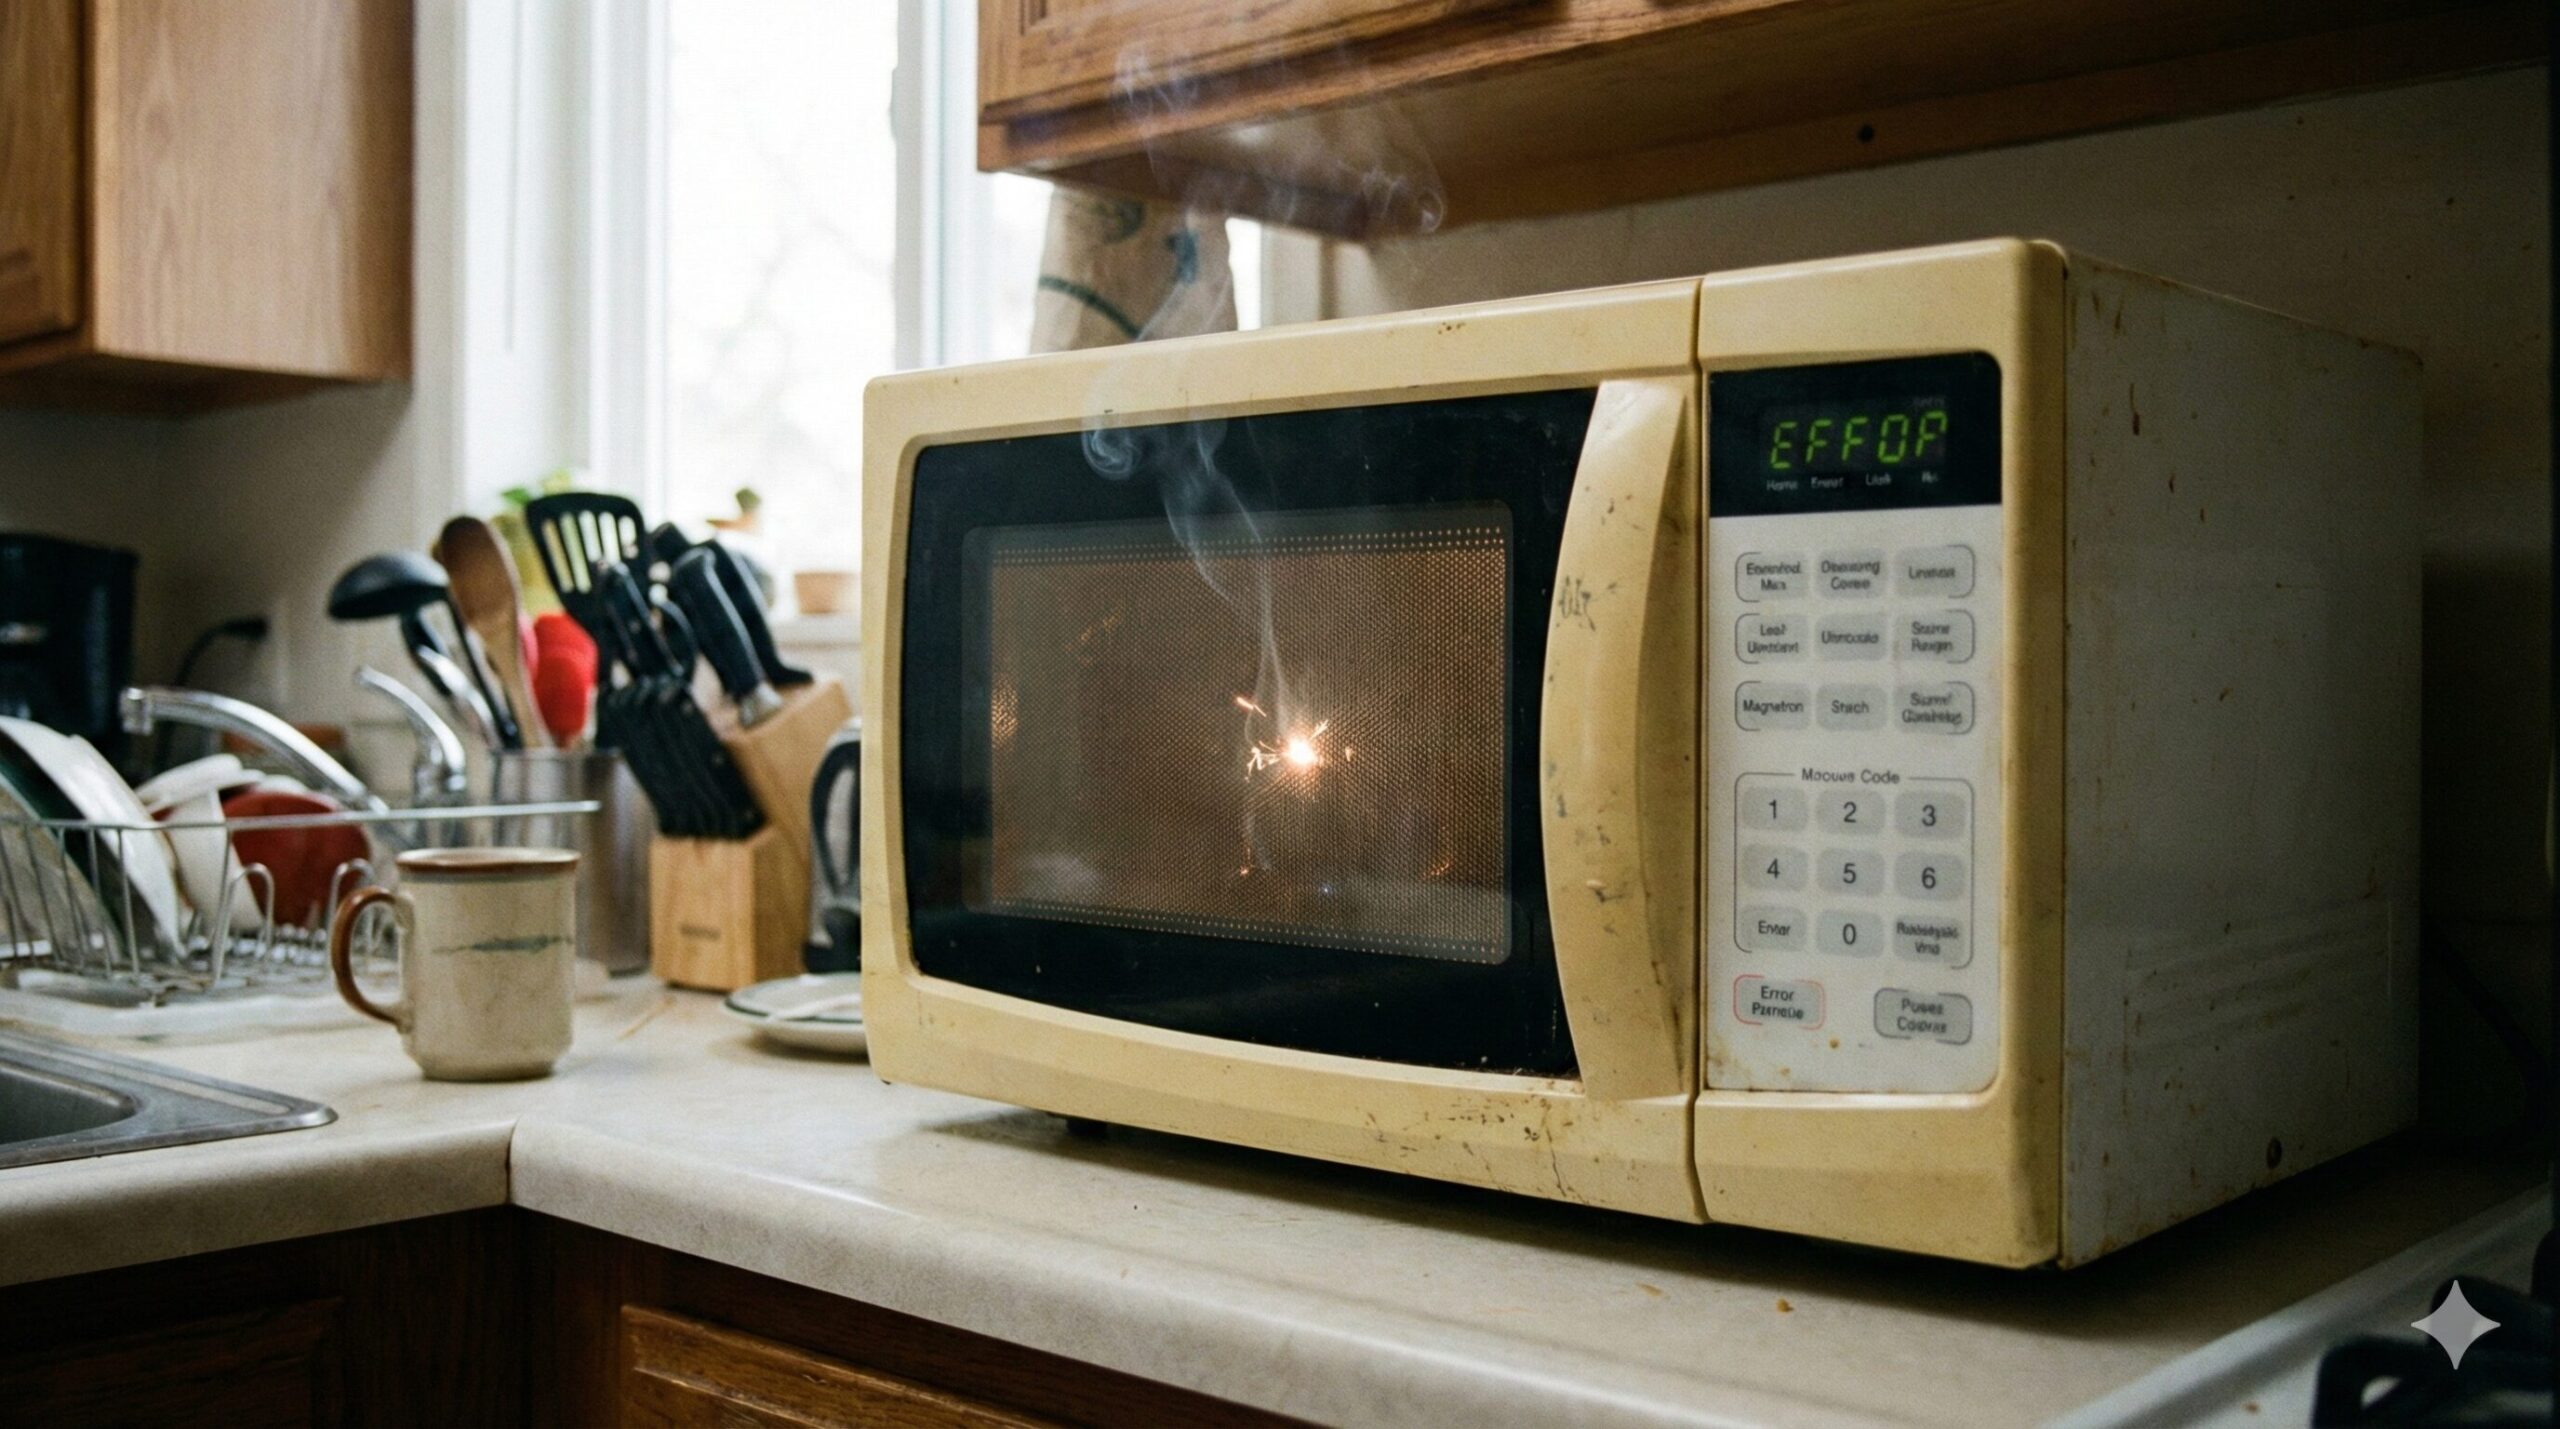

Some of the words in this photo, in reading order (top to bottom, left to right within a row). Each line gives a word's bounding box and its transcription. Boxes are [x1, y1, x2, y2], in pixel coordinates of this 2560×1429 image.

[1743, 700, 1804, 715] Magnetron
[1861, 769, 1900, 784] Code
[1769, 800, 1778, 819] 1
[1843, 801, 1857, 823] 2
[1921, 805, 1937, 826] 3
[1767, 859, 1780, 879] 4
[1843, 863, 1857, 884] 5
[1921, 867, 1937, 889] 6
[1842, 923, 1857, 945] 0
[1761, 986, 1795, 1001] Error
